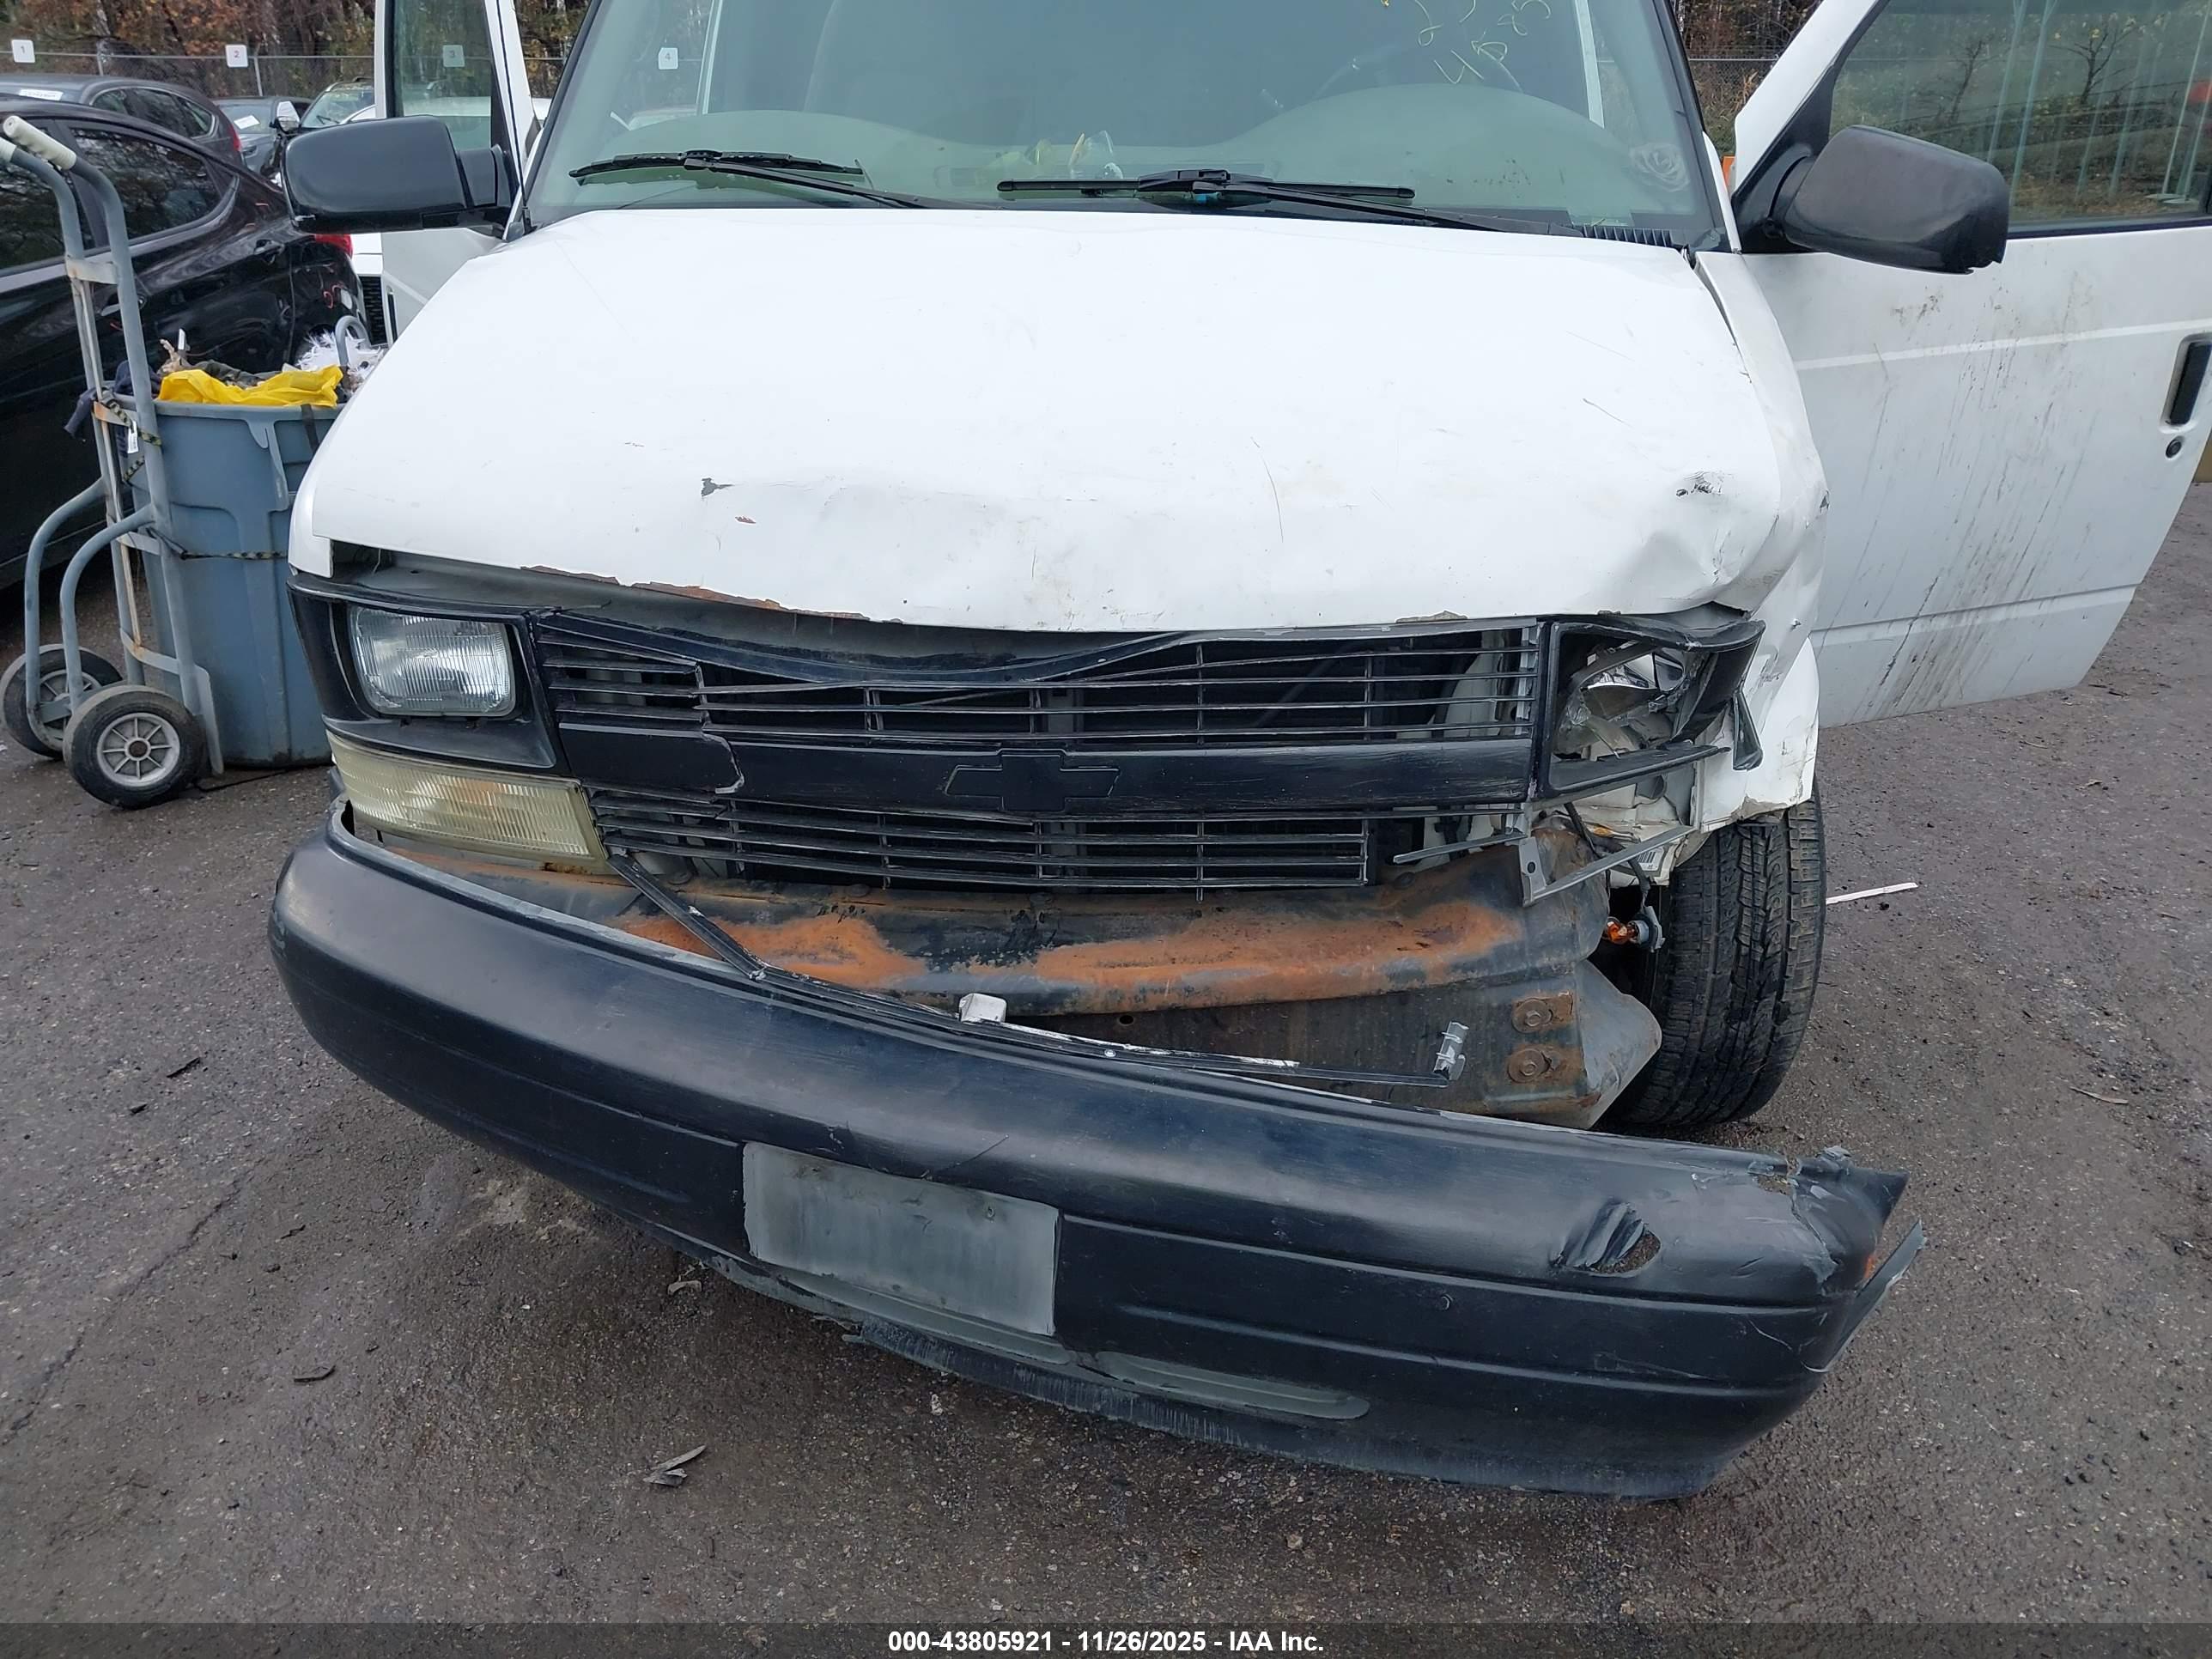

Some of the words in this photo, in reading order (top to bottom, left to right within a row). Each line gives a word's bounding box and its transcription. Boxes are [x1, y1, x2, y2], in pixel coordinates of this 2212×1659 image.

[20, 46, 25, 54] 1
[234, 50, 240, 58] 2
[449, 50, 456, 58] 3
[665, 52, 672, 61] 4
